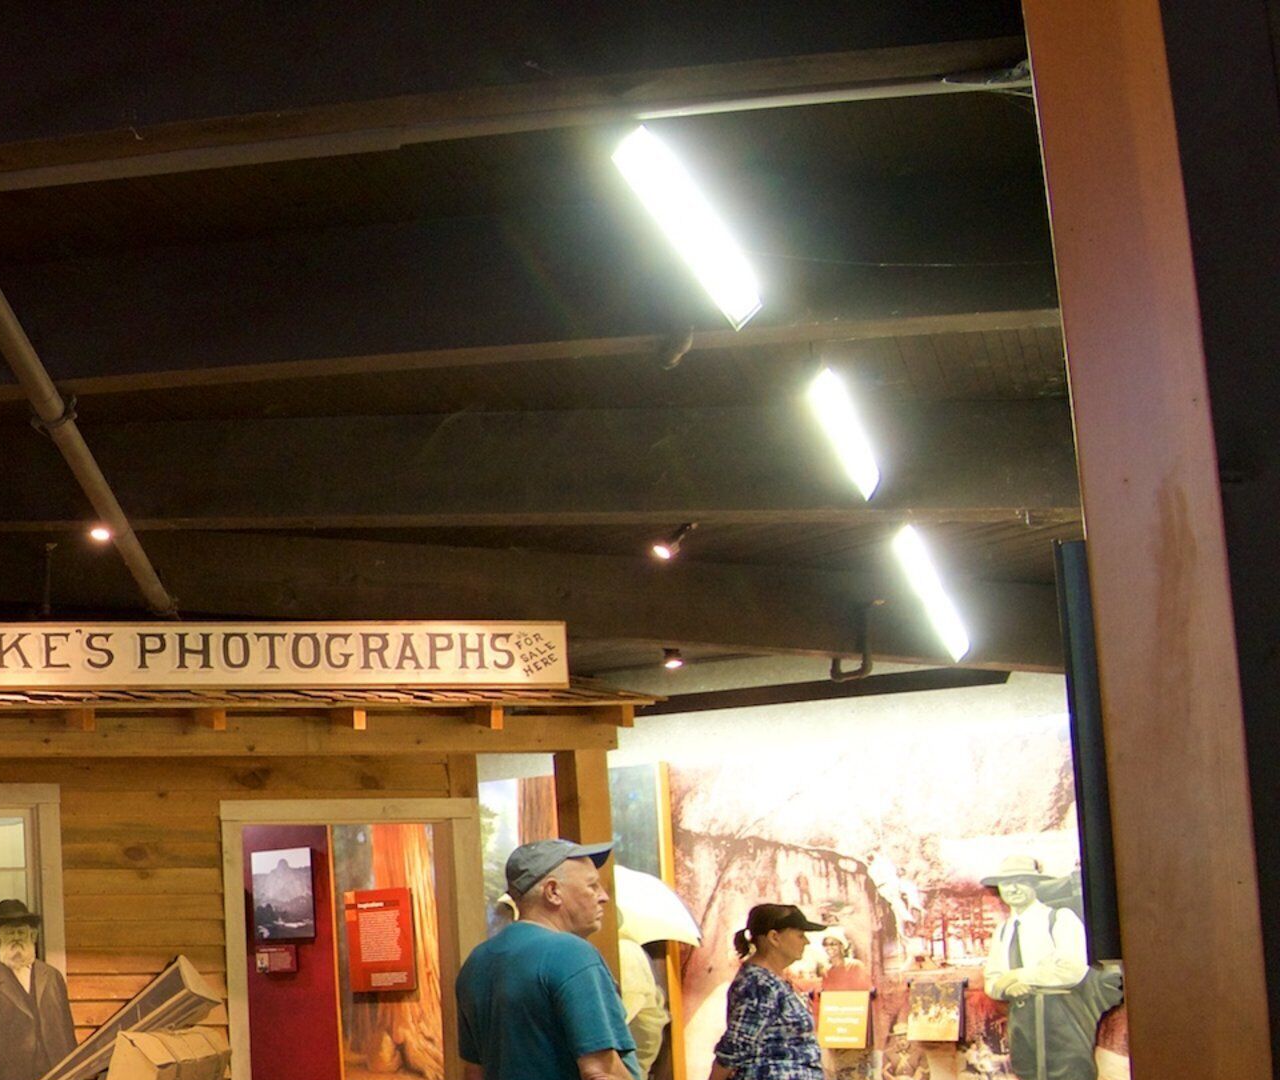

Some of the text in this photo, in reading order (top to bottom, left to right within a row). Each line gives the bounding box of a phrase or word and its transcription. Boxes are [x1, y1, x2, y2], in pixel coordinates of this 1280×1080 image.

[137, 632, 515, 670] PHOTOGRAPHS
[515, 633, 544, 650] FOR
[520, 641, 556, 663] SALE
[523, 653, 558, 677] HERE
